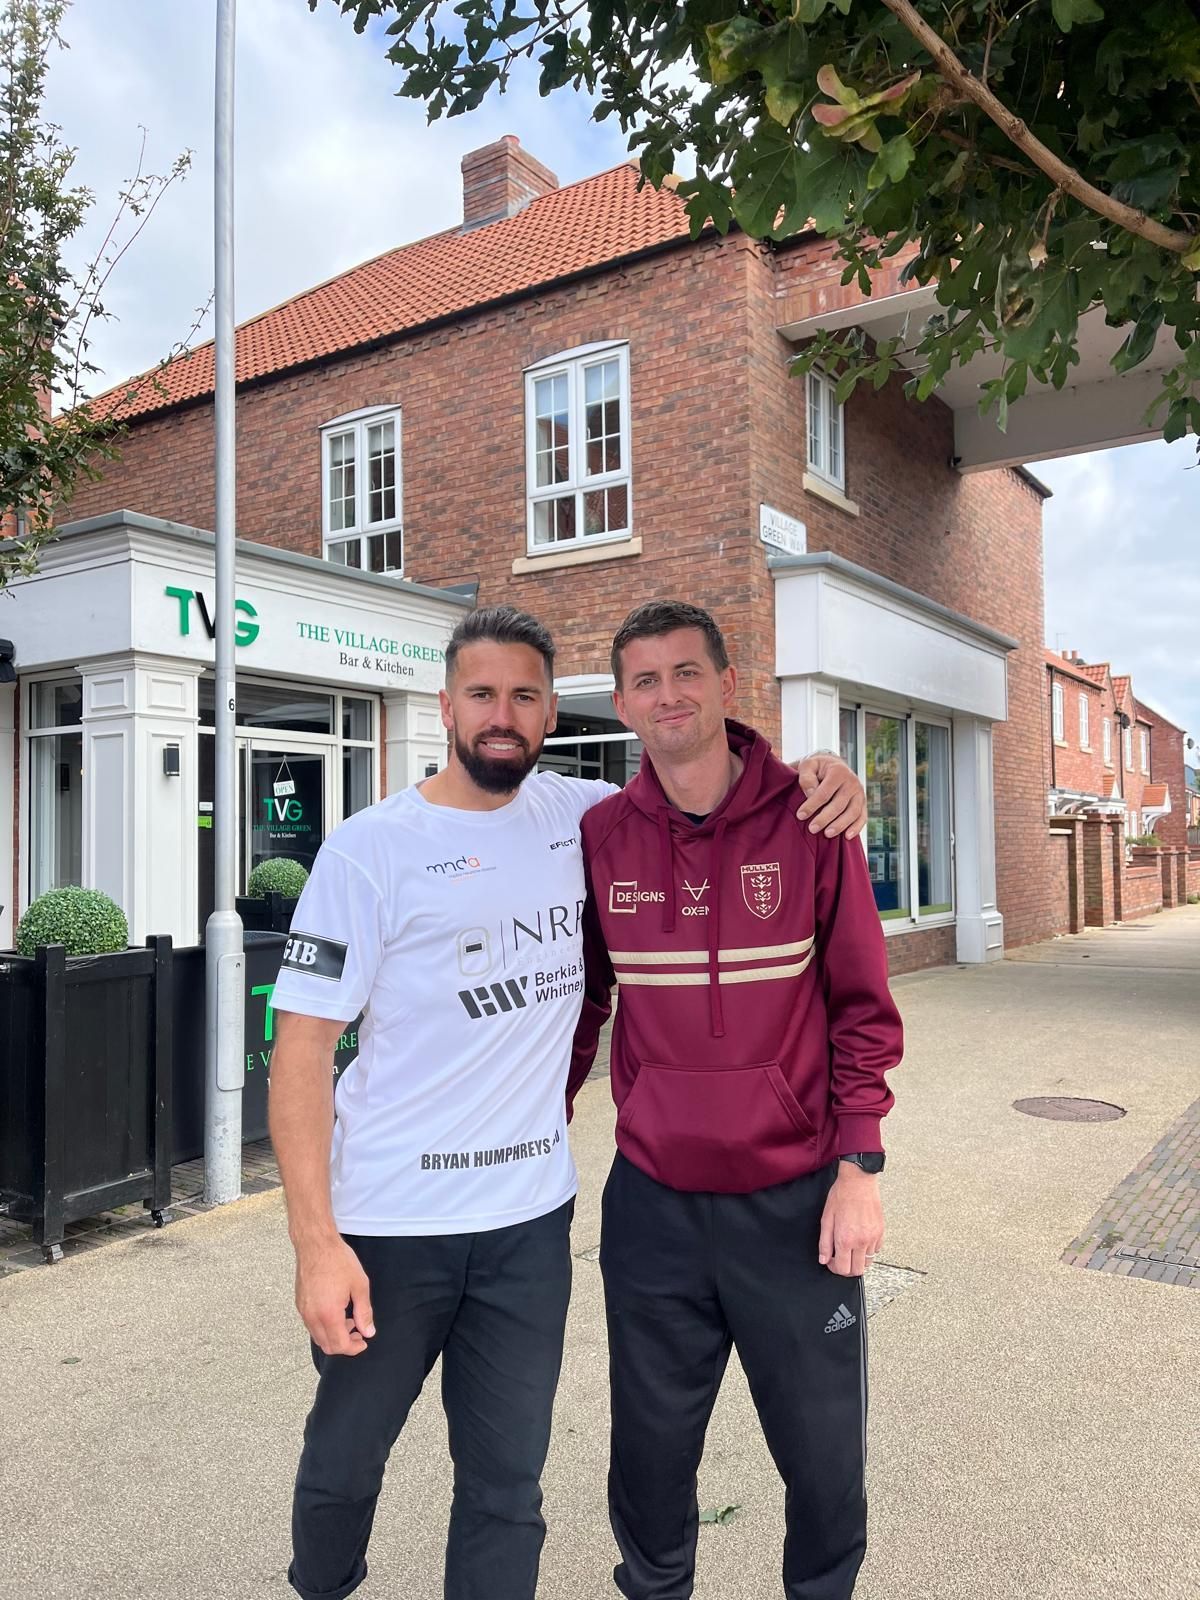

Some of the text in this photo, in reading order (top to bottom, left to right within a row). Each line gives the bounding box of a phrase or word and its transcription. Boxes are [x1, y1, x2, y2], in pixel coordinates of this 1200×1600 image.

[297, 622, 447, 664] THE VILLAGE GREEN
[340, 653, 414, 676] Bar & Kitchen
[228, 698, 235, 711] 6
[275, 785, 293, 795] OPEN
[263, 798, 303, 821] TVG
[426, 856, 480, 874] mnda
[617, 892, 665, 903] DESIGNS
[535, 964, 577, 987] Berkia
[536, 980, 583, 1003] Whitney
[421, 1138, 551, 1170] BRYAN HUMPHREYS
[824, 1316, 856, 1334] adidas
